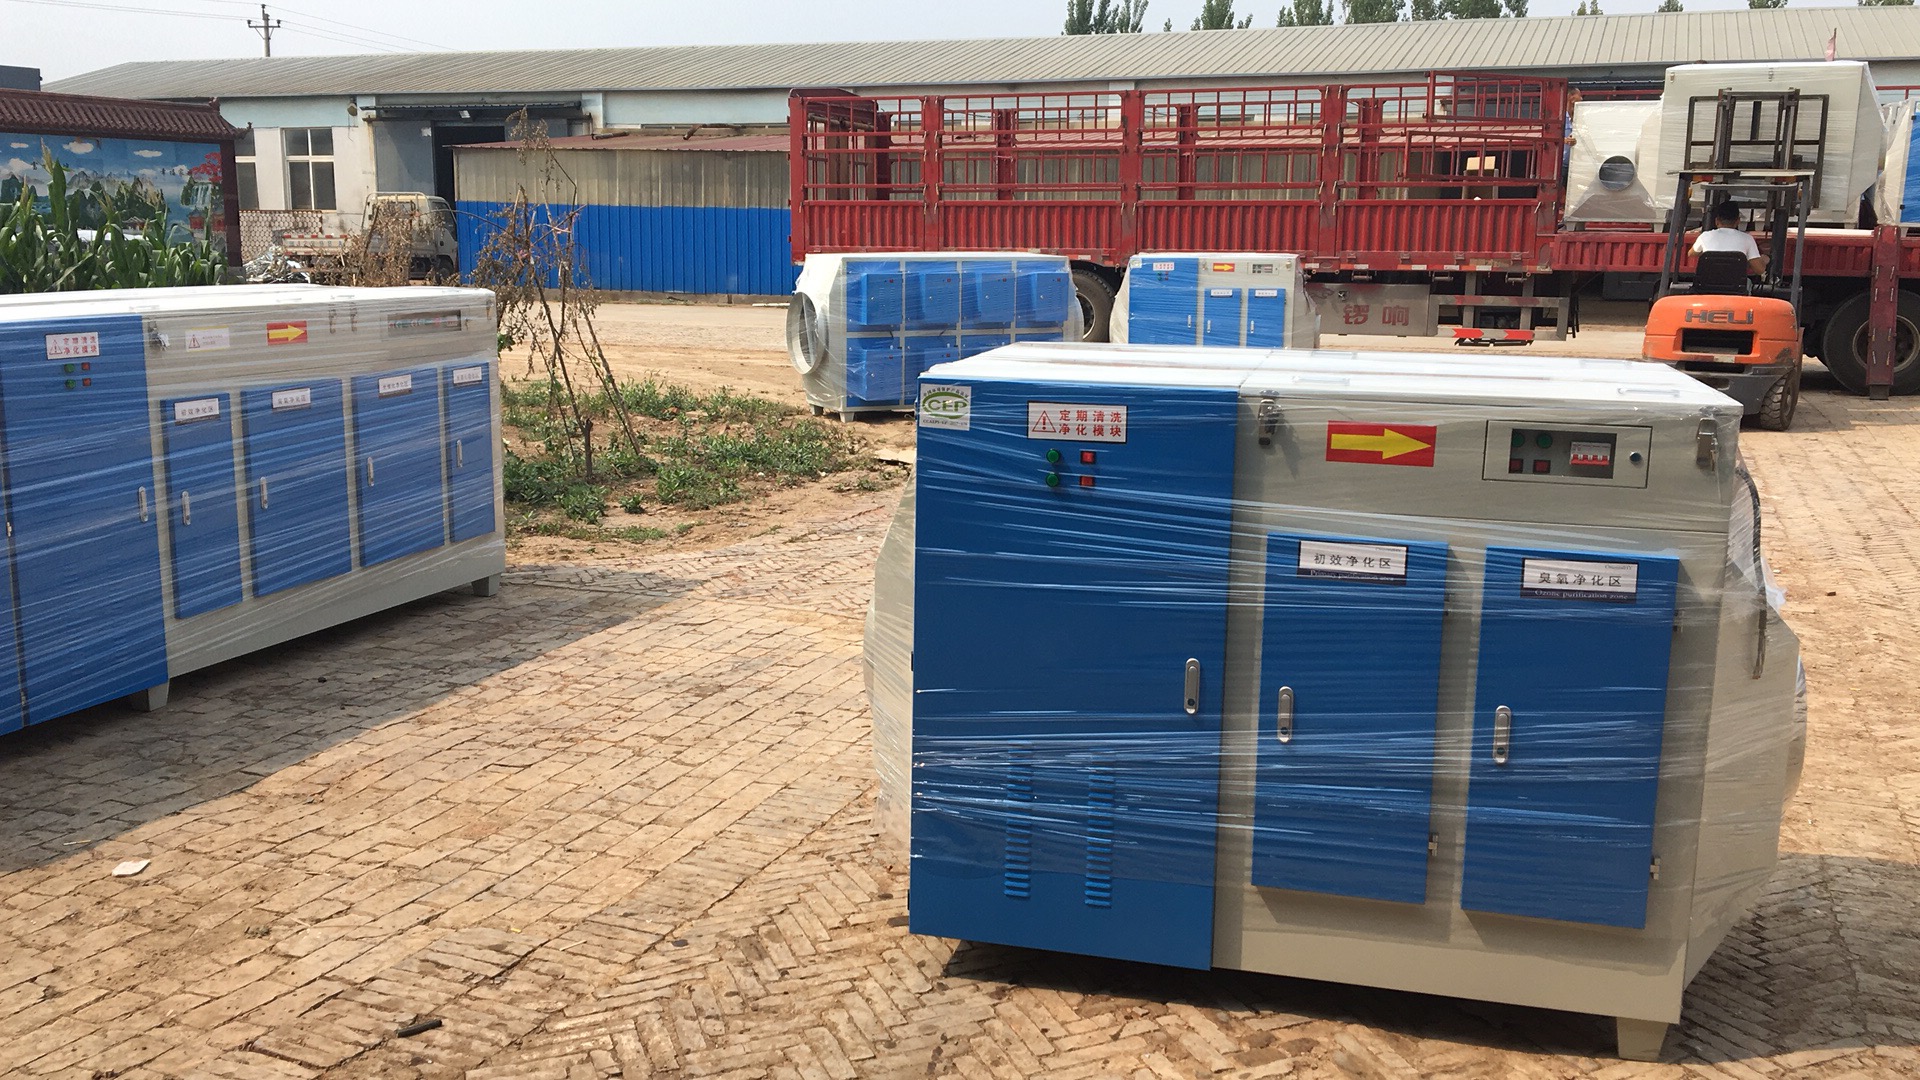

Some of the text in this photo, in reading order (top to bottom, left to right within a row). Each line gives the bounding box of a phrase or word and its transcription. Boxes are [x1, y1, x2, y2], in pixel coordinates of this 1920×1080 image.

[1685, 309, 1754, 325] HELI
[1059, 409, 1122, 423] 定期清洗
[1058, 422, 1122, 437] 净化模块
[1314, 553, 1391, 569] 初效净化区
[1539, 572, 1622, 587] 臭氧净化区
